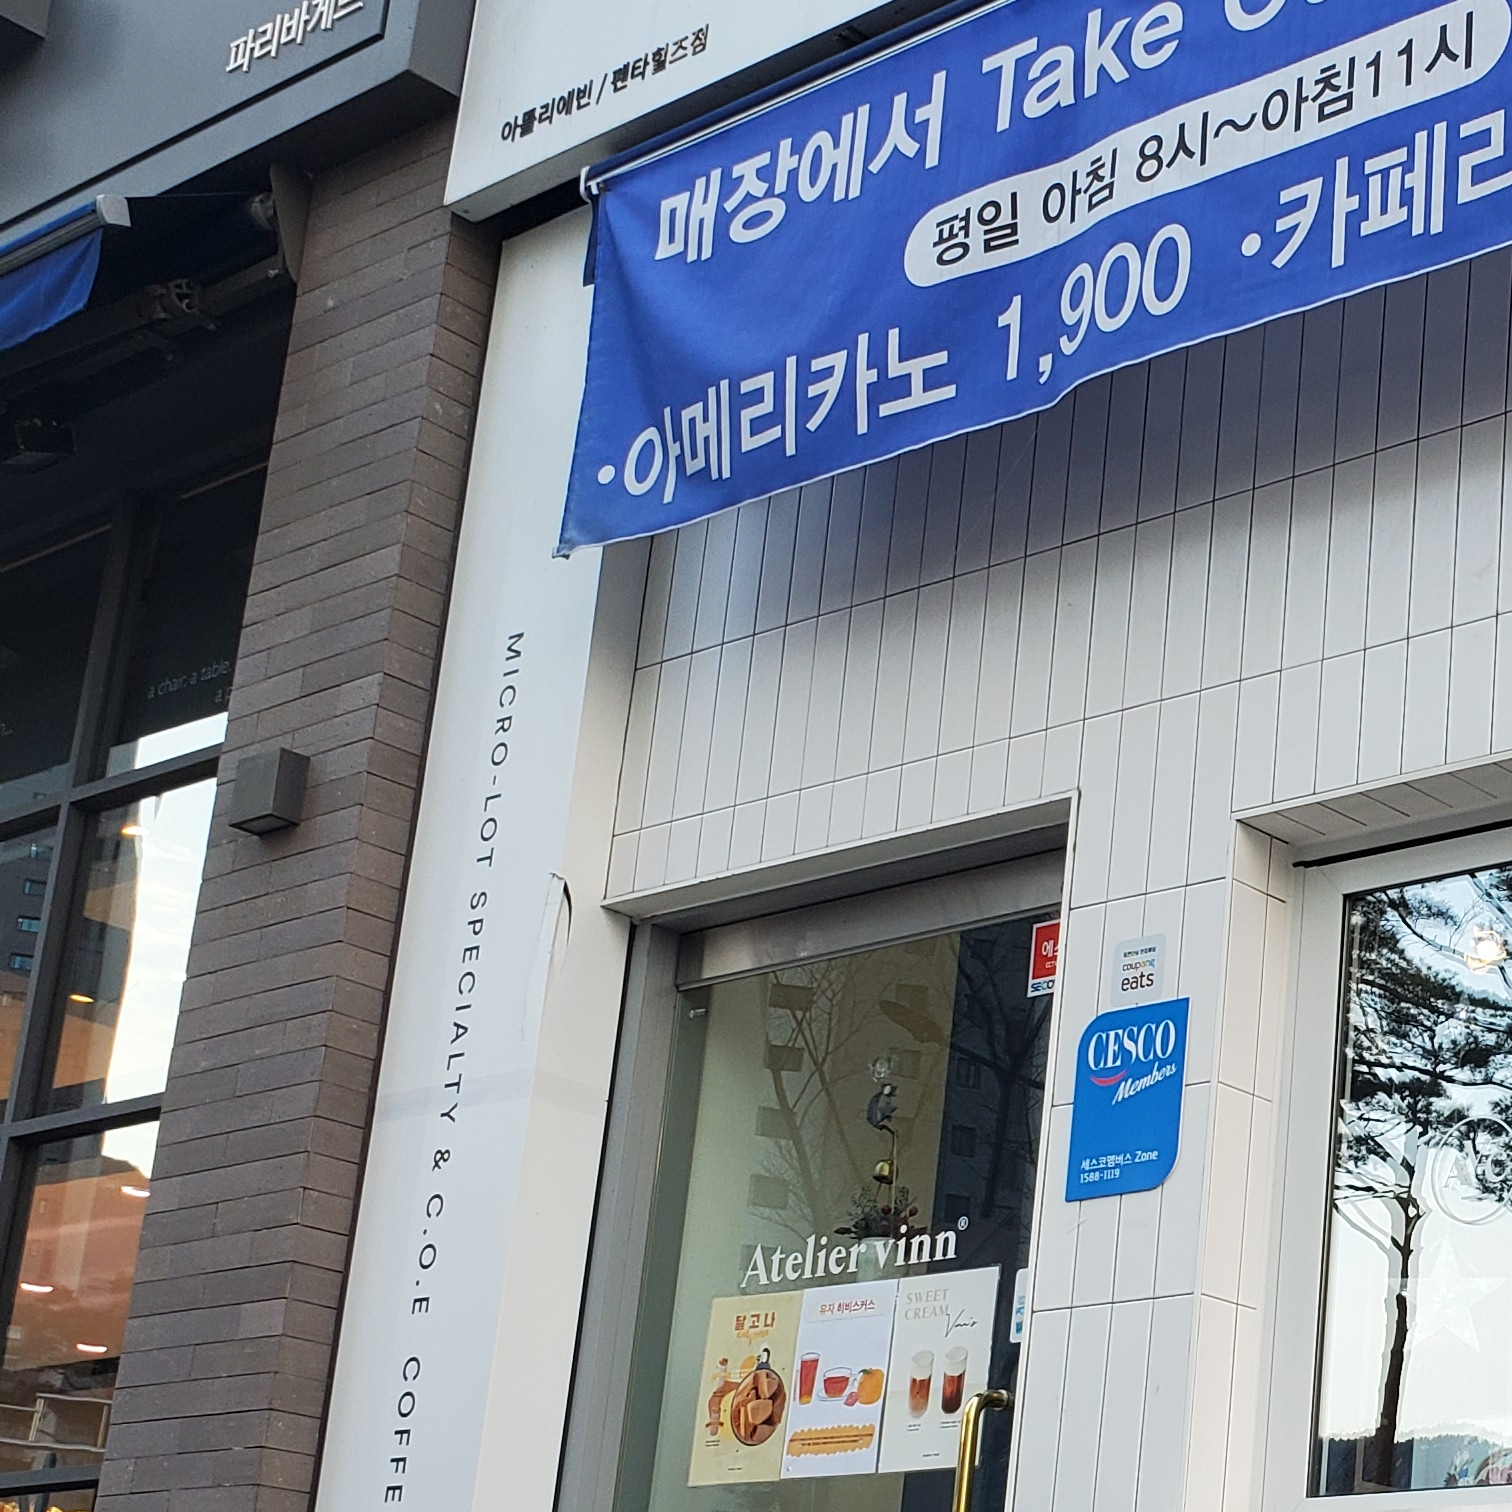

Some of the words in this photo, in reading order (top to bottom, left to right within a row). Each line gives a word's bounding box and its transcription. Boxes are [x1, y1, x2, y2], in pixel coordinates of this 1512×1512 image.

[611, 23, 709, 93] 펜타힐즈점
[654, 70, 947, 263] 매장에서
[982, 0, 1184, 133] Take
[932, 199, 1020, 267] 평일
[1042, 149, 1117, 226] 아침
[996, 223, 1192, 385] 1,900
[476, 632, 525, 867] MICRO-LOT
[1121, 971, 1155, 991] eats
[1122, 958, 1155, 971] coupang
[440, 891, 488, 1123] SPECIALTY
[1088, 1019, 1176, 1071] CESCO
[1111, 1061, 1177, 1105] Members
[432, 1149, 450, 1172] &
[1080, 1168, 1120, 1184] 1588-1119
[1134, 1150, 1159, 1163] Zone
[740, 1234, 867, 1288] Atelier
[904, 1304, 949, 1321] CREAM
[906, 1289, 950, 1305] SWEET
